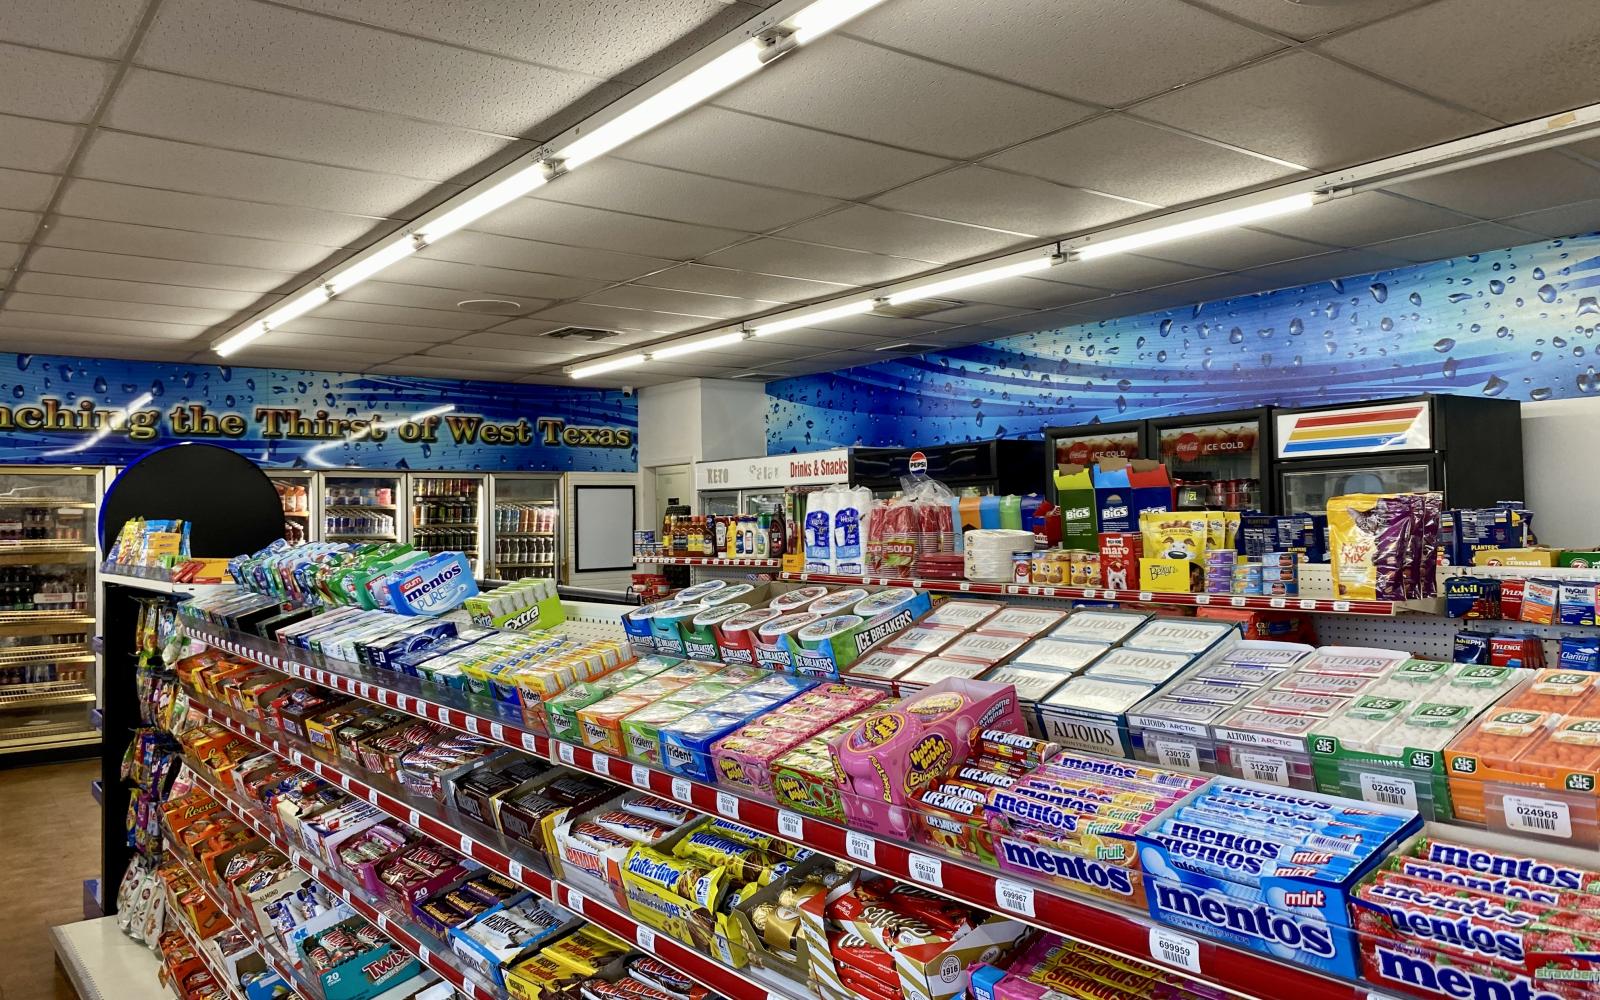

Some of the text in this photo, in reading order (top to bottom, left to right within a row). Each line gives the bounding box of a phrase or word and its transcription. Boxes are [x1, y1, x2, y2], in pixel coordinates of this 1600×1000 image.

[170, 404, 246, 436] the
[256, 408, 385, 441] Thirst
[399, 414, 441, 442] of
[445, 416, 533, 446] West
[538, 418, 631, 447] Texas
[1220, 441, 1244, 450] COLD
[1092, 450, 1126, 459] ICE COLD
[790, 460, 812, 478] Drinks
[813, 460, 819, 477] &
[820, 457, 848, 476] Snacks
[910, 461, 927, 469] PEPSI
[405, 564, 462, 602] mentos
[405, 578, 422, 590] GUM
[1450, 584, 1478, 593] Advil
[1502, 588, 1523, 596] TYLEN
[1565, 587, 1588, 595] NyQuil
[417, 588, 447, 611] PURE
[504, 605, 540, 630] Extra
[855, 630, 873, 652] ICE
[871, 610, 913, 641] BREAKERS
[1146, 626, 1213, 640] ALTOIDS
[1491, 643, 1521, 651] TYLENOL
[763, 650, 791, 667] BREAKERS
[1107, 655, 1177, 670] ALTOIDS
[1561, 651, 1589, 661] Claritin
[802, 656, 833, 673] BREAKERS
[583, 723, 607, 740] Trident
[1139, 718, 1197, 733] ALTOIDS ARCTIC
[627, 732, 654, 750] Trident
[1053, 720, 1115, 747] ALTOIDS
[1226, 731, 1292, 747] ALTOIDS ARCTIC
[666, 743, 693, 763] Trident
[1165, 749, 1191, 759] 230128
[1316, 744, 1332, 752] tac
[1412, 759, 1430, 767] tac
[1416, 752, 1430, 760] tic
[1459, 757, 1474, 765] tic
[1062, 756, 1137, 779] mentos
[1250, 762, 1279, 773] 312397
[1455, 764, 1473, 772] tac
[1569, 782, 1589, 791] tac
[1572, 775, 1589, 783] tic
[1371, 783, 1407, 796] 024950
[1014, 787, 1100, 815] mentos
[992, 794, 1079, 832] mentos
[1516, 806, 1559, 820] 024968
[1085, 820, 1123, 836] fruit
[1170, 822, 1284, 861] mentos
[1095, 844, 1126, 861] fruit
[1156, 834, 1265, 876] mentos
[1290, 851, 1333, 865] mint
[914, 862, 936, 875] 656330
[1002, 837, 1135, 897] mentos
[1428, 842, 1584, 890] mentos
[414, 887, 428, 900] 20
[1002, 888, 1028, 903] 699967
[1284, 890, 1326, 908] mint
[1368, 882, 1540, 928] mentos
[1154, 882, 1334, 958] mentos
[1158, 940, 1191, 957] 699959
[326, 972, 340, 984] 20
[942, 964, 959, 977] 1916
